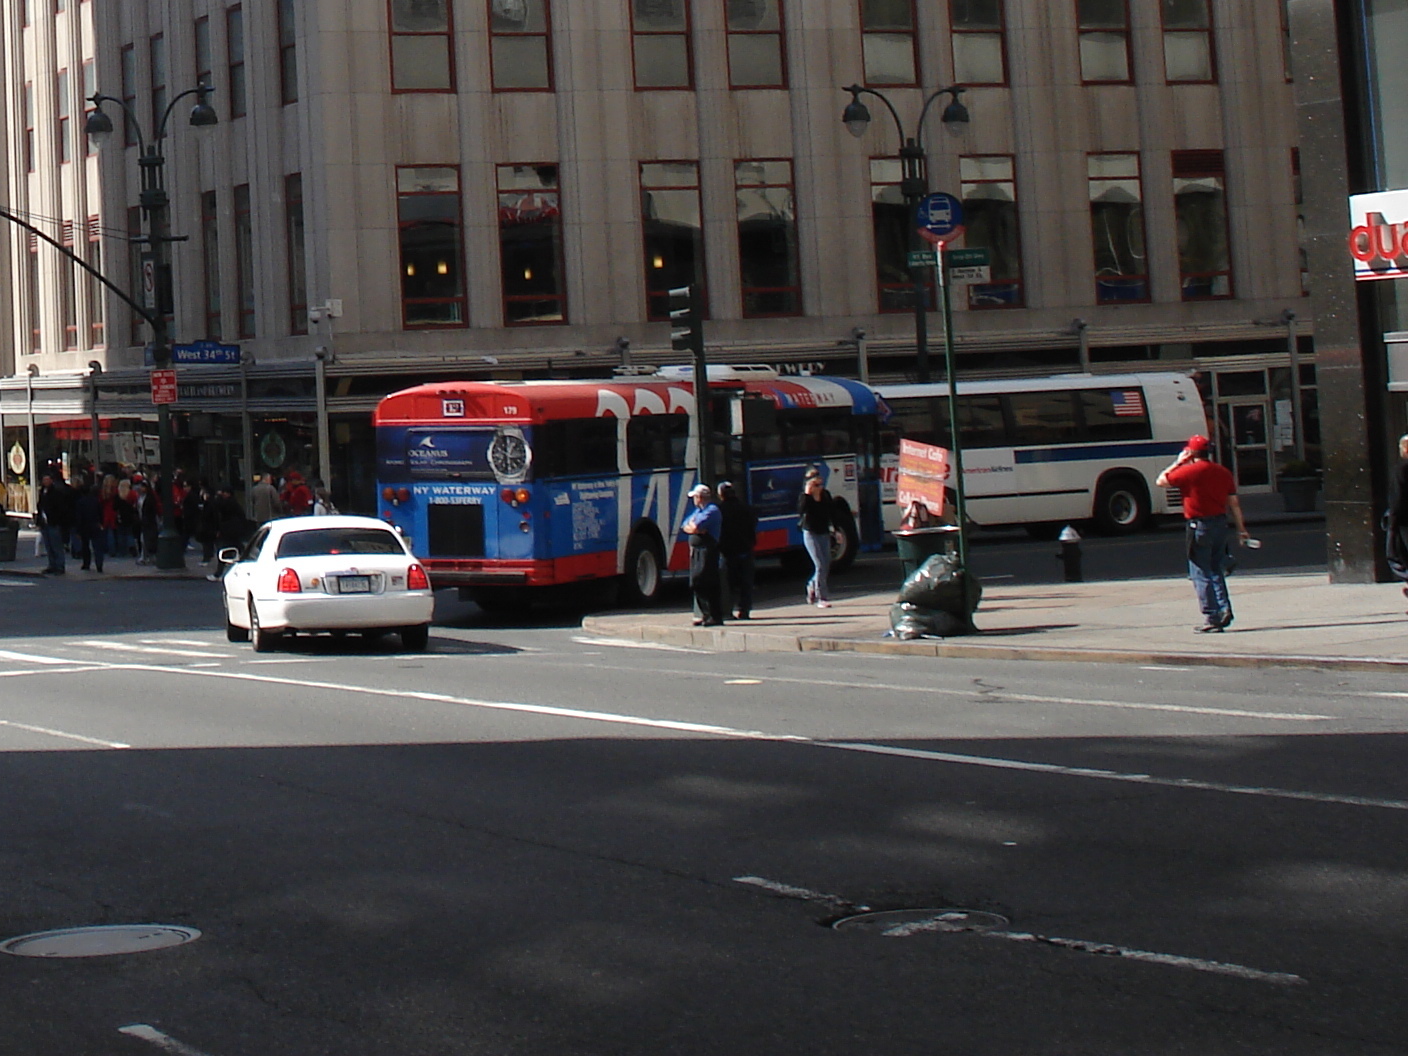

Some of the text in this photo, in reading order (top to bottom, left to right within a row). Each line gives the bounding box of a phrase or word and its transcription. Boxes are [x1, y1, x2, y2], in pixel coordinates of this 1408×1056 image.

[1349, 211, 1408, 262] du
[177, 349, 236, 360] West 34th St
[902, 442, 927, 458] Internet
[414, 486, 496, 495] NY WATERWAY
